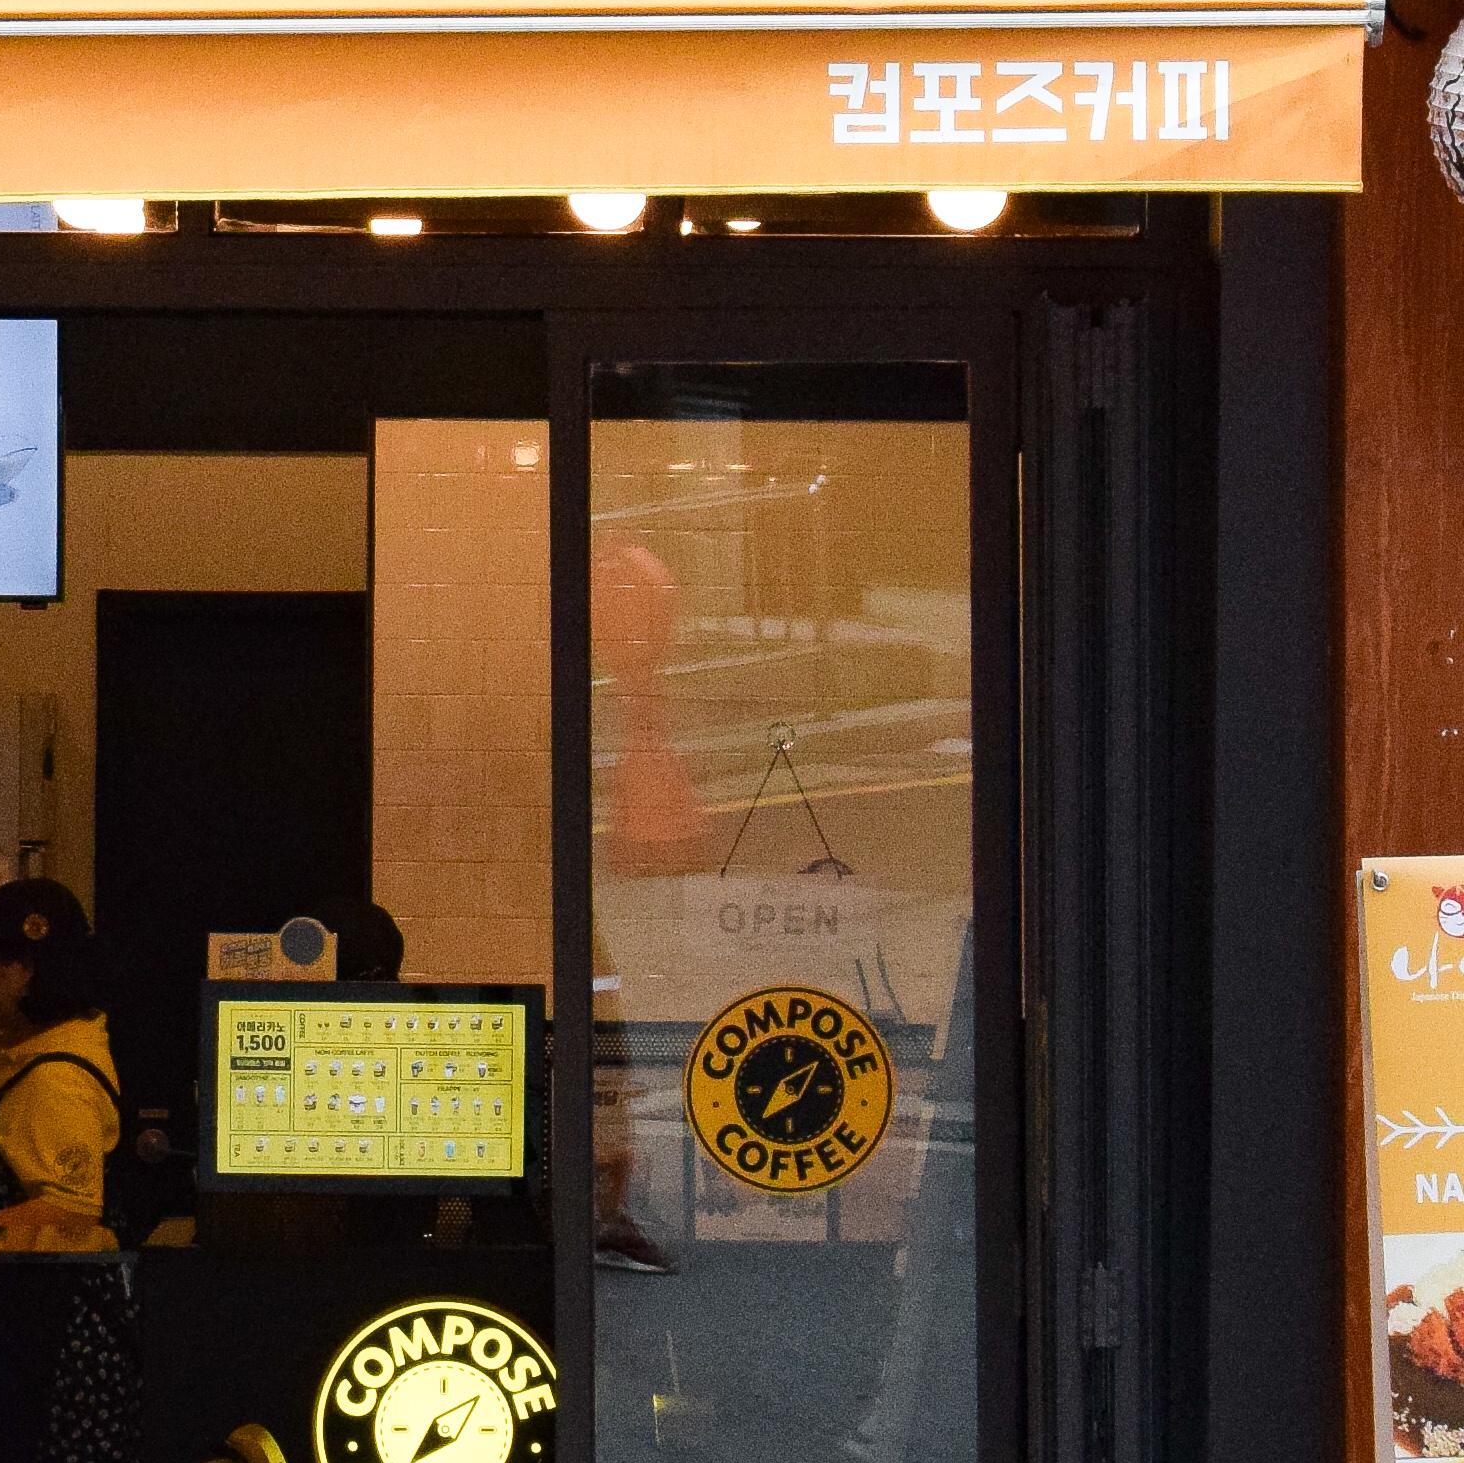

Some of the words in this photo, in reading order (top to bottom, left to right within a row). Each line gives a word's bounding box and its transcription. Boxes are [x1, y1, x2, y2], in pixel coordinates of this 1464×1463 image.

[827, 60, 1229, 143] 컴포즈커피
[717, 902, 839, 935] OPEN
[236, 1020, 286, 1034] 아메리카노
[236, 1034, 286, 1053] 1,500
[702, 997, 878, 1080] COMPOSE
[716, 1120, 867, 1181] COFFEE
[336, 1315, 556, 1420] COMPOSE
